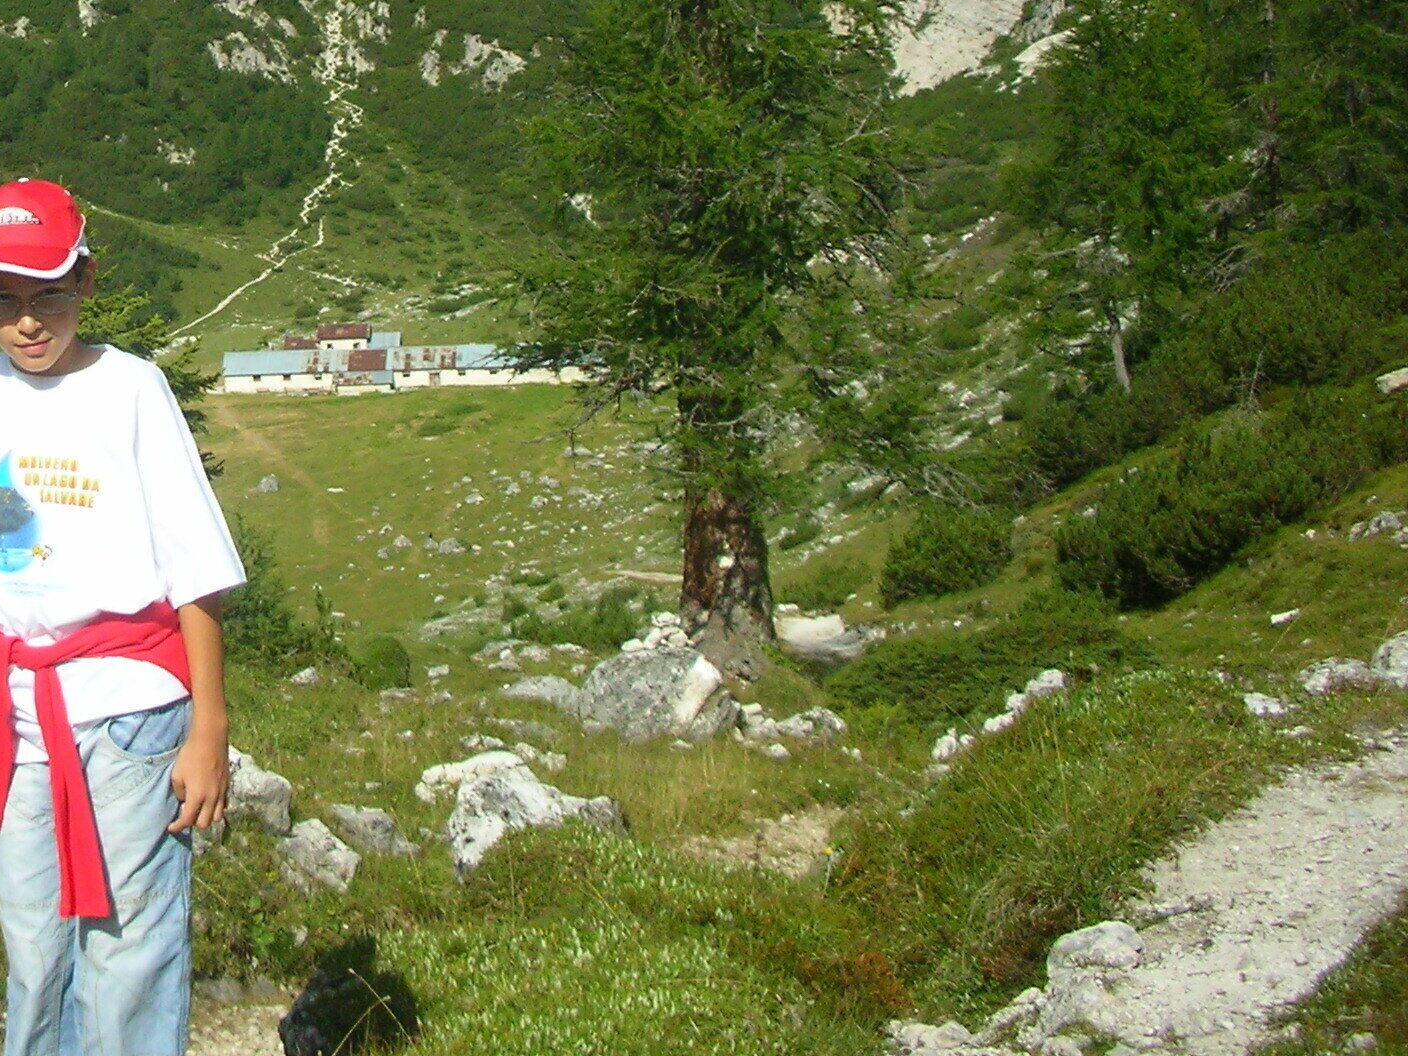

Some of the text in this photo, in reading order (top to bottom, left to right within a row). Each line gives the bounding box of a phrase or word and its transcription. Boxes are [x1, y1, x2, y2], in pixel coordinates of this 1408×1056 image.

[18, 456, 79, 472] MOLVENO
[24, 473, 100, 492] UN LAGO DA
[40, 489, 95, 509] SALVARE
